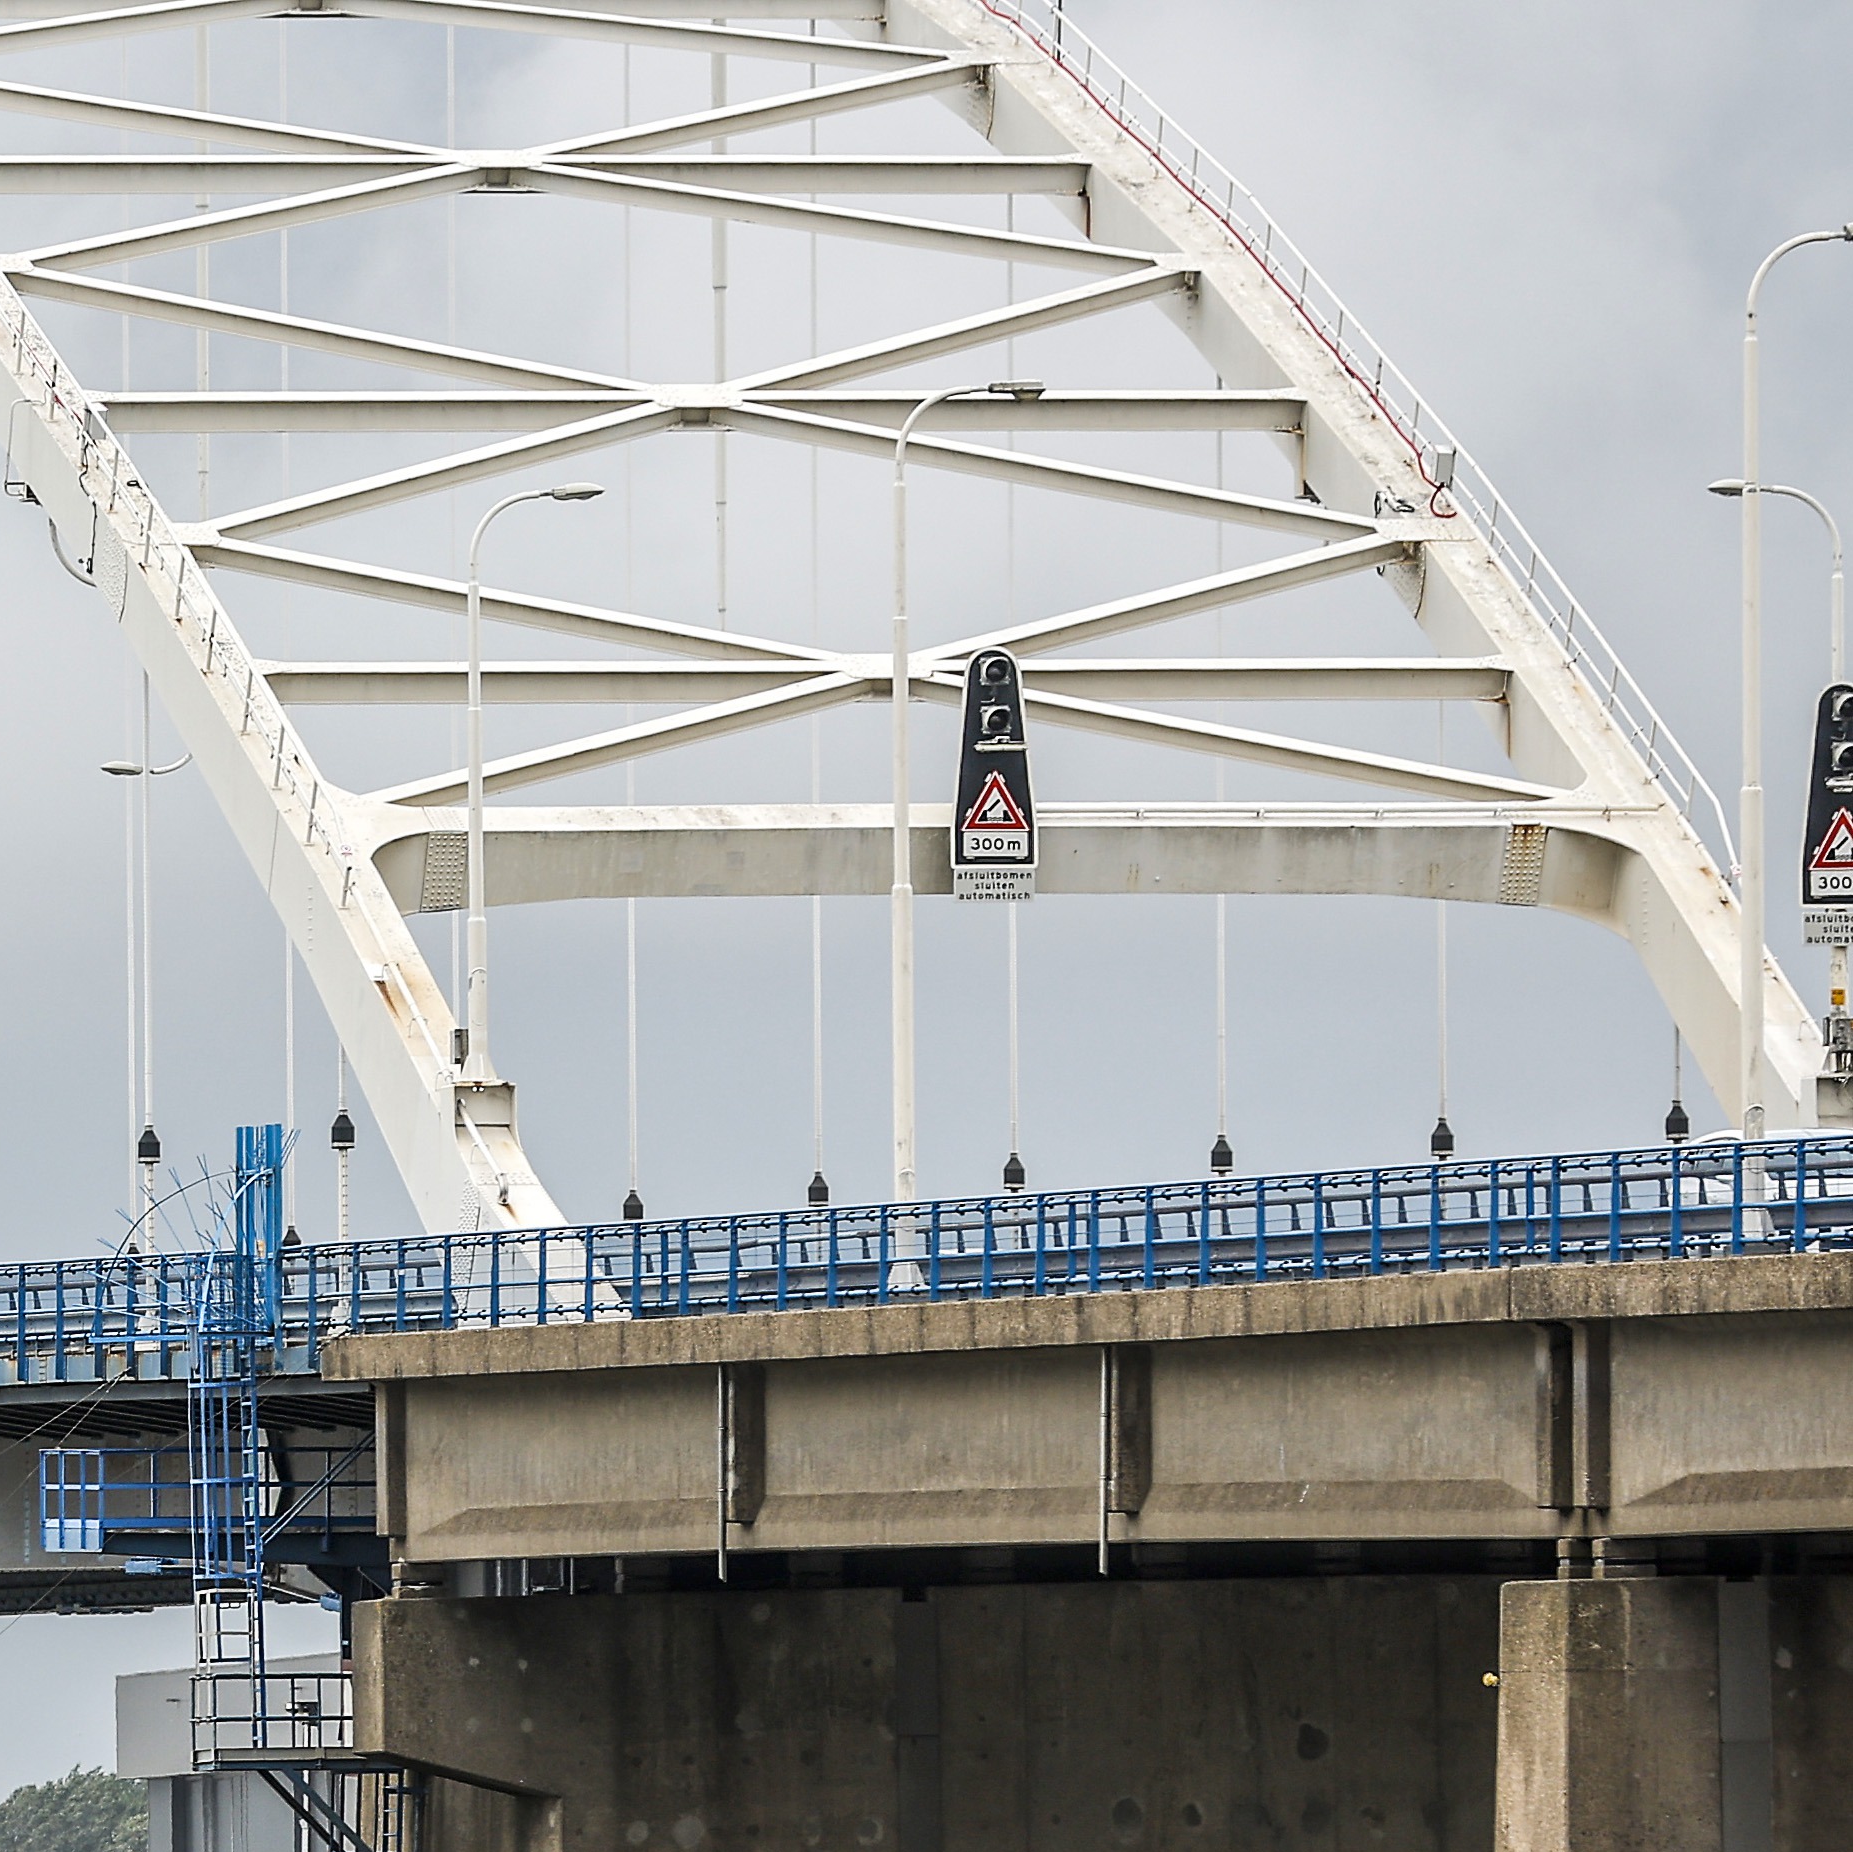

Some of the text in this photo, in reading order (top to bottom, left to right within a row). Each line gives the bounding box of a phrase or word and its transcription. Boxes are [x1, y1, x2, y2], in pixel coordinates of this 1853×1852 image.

[956, 871, 1032, 880] afsluitbomen
[974, 882, 1015, 890] sluiten
[1818, 876, 1852, 889] 300
[958, 892, 1031, 900] automatisch
